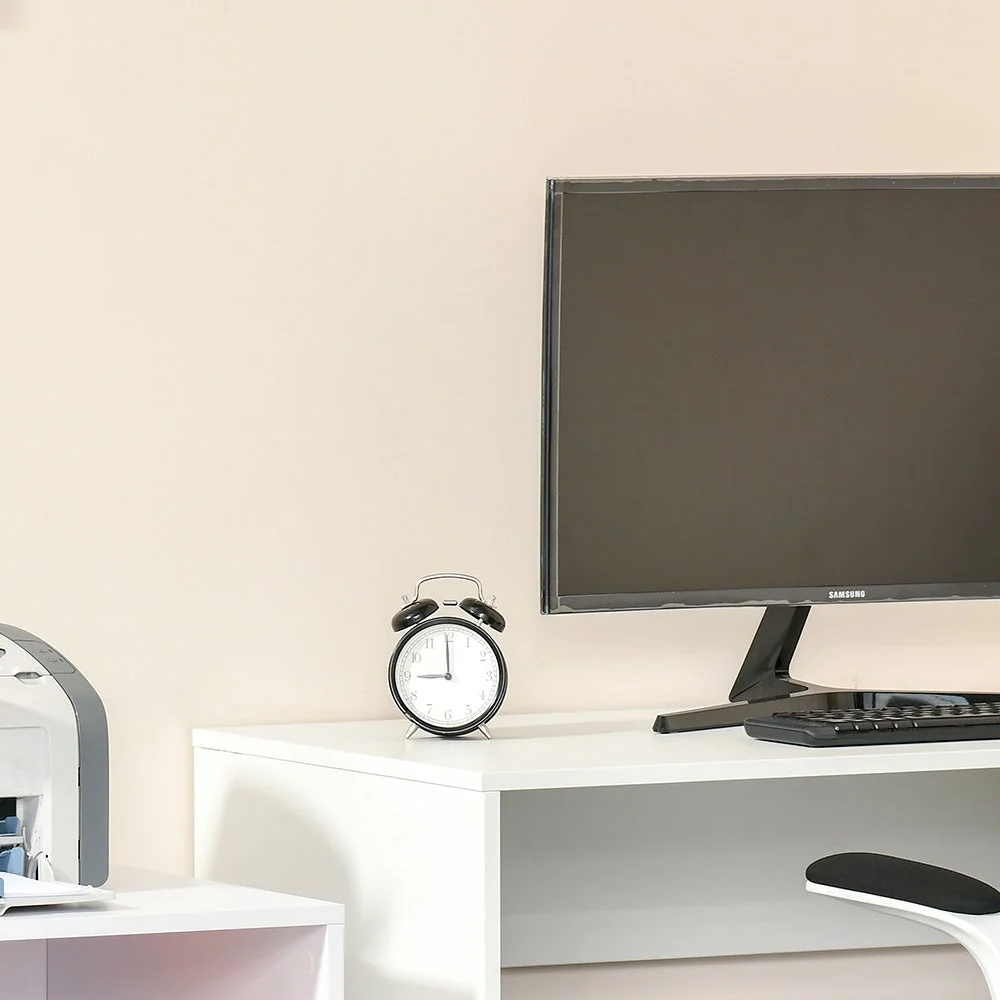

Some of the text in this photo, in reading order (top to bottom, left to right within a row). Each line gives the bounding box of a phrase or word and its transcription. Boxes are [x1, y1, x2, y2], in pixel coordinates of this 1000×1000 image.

[828, 590, 866, 599] SAMSUNG
[411, 652, 422, 663] 10
[479, 651, 487, 662] 2
[403, 671, 411, 682] 9
[486, 671, 493, 682] 3
[444, 709, 452, 720] 6
